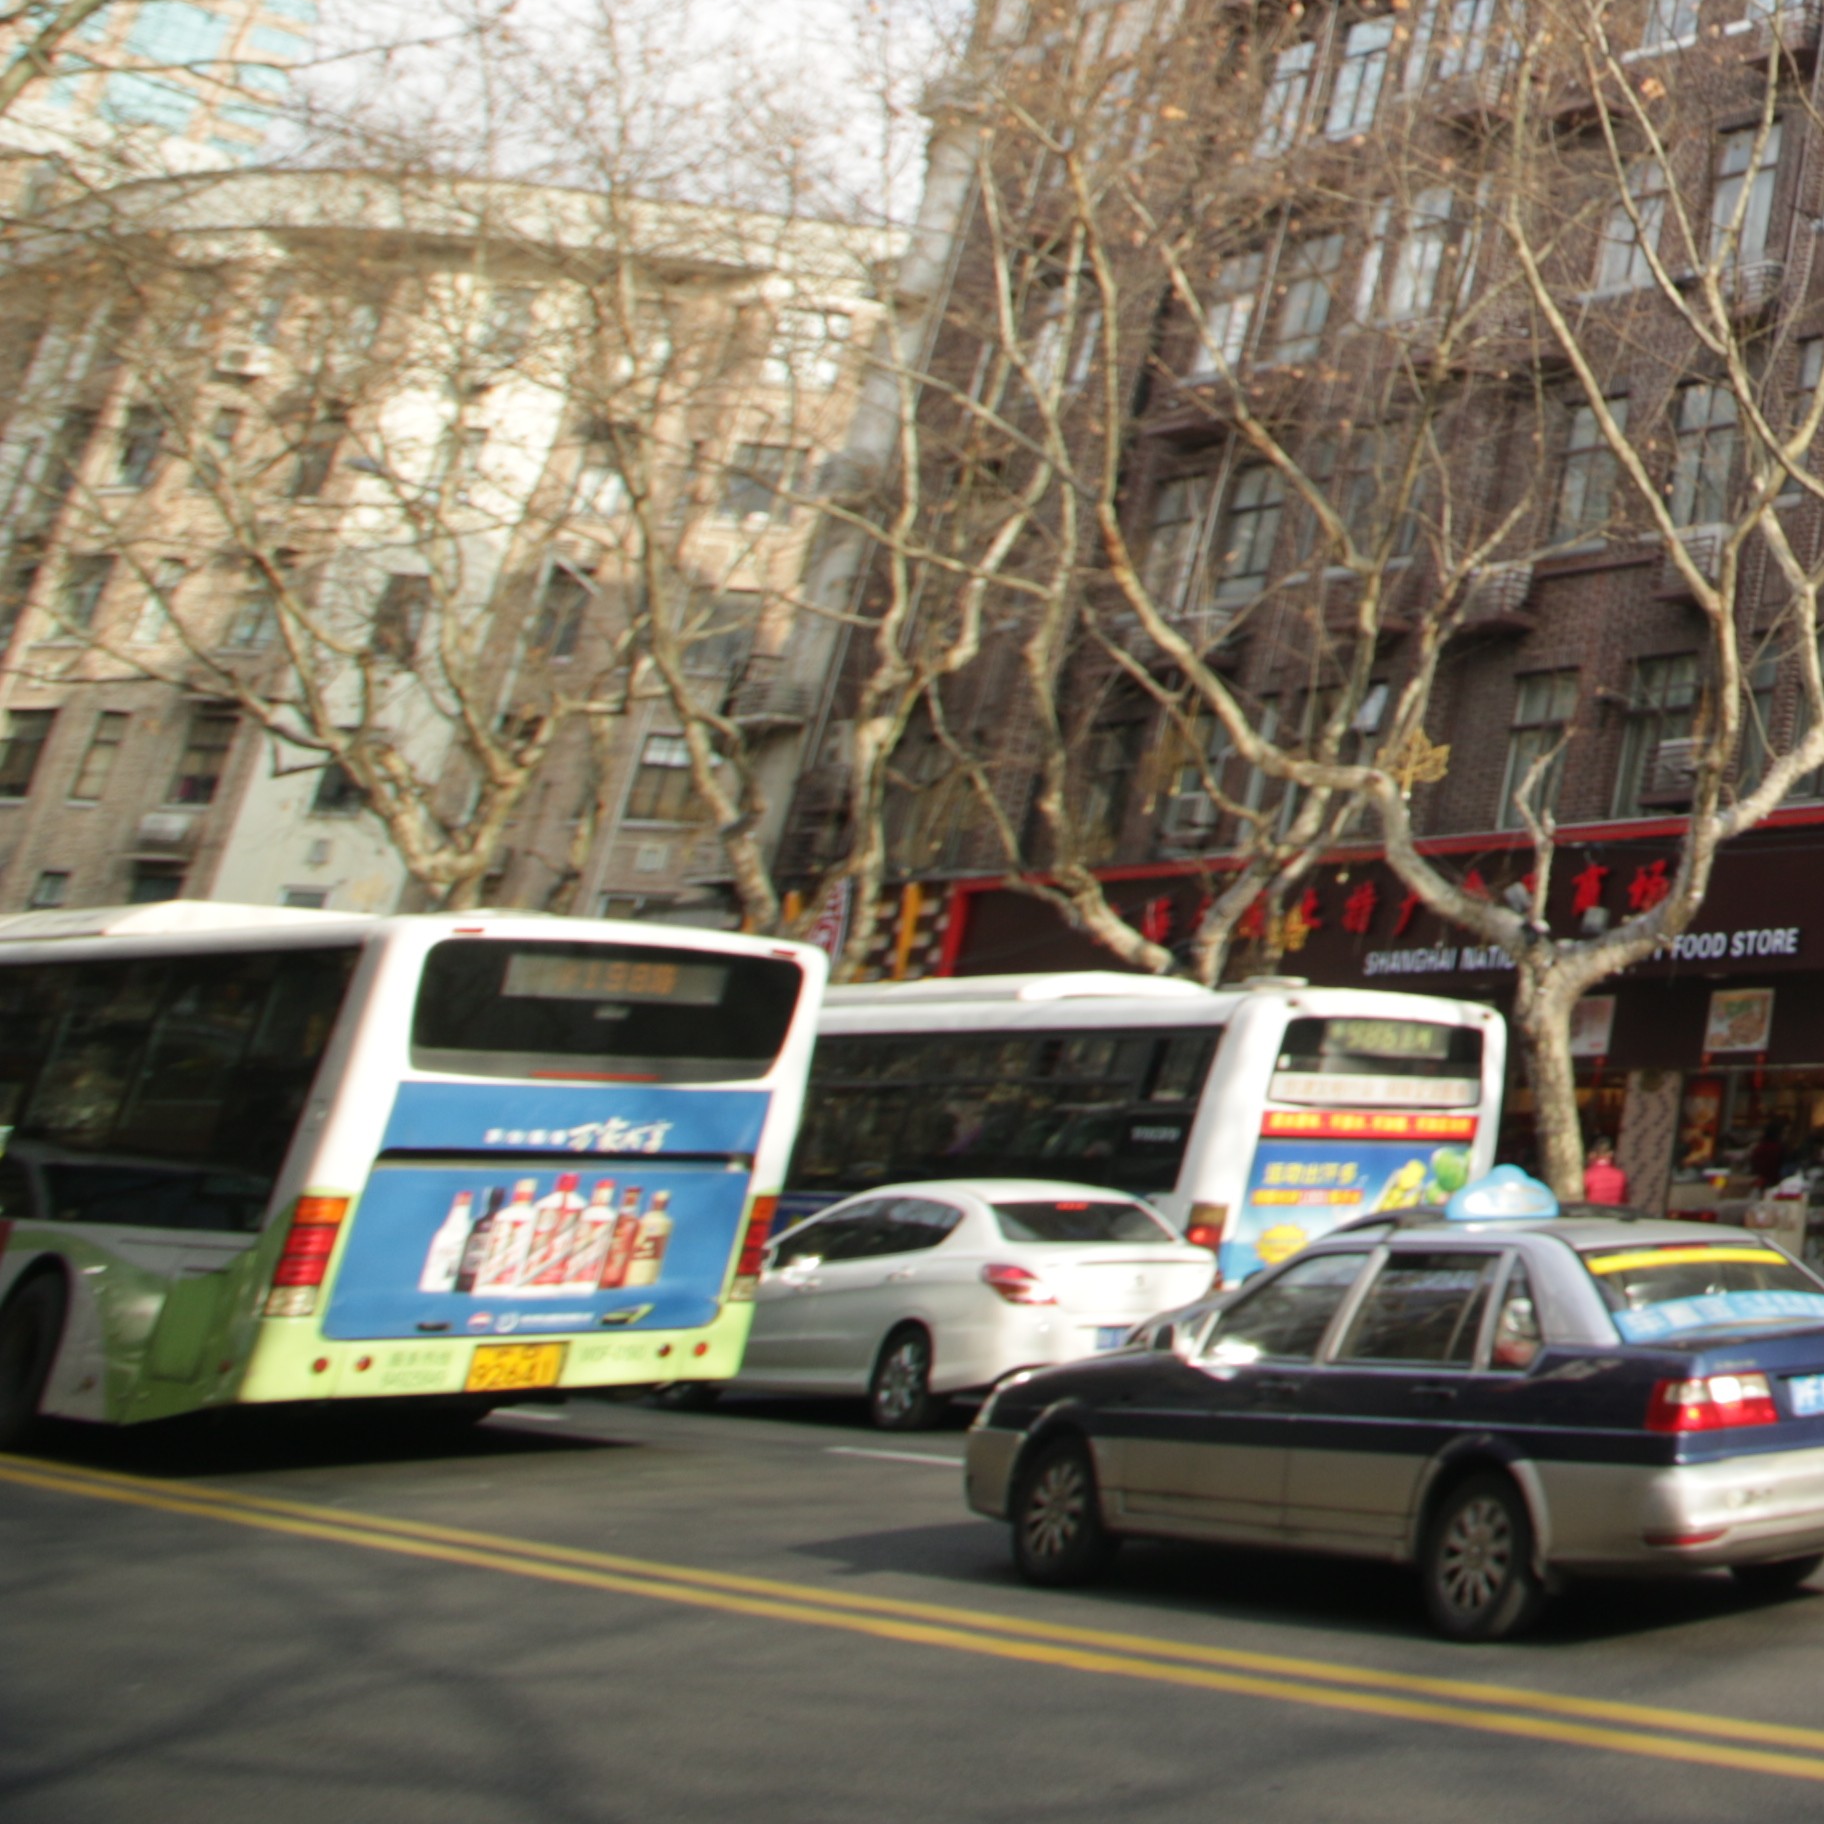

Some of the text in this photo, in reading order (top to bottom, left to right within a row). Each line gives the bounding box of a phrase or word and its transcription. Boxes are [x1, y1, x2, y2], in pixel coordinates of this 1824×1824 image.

[1363, 948, 1458, 976] SHANGHAI
[1671, 932, 1727, 961] FOOD
[1730, 927, 1799, 958] STORE
